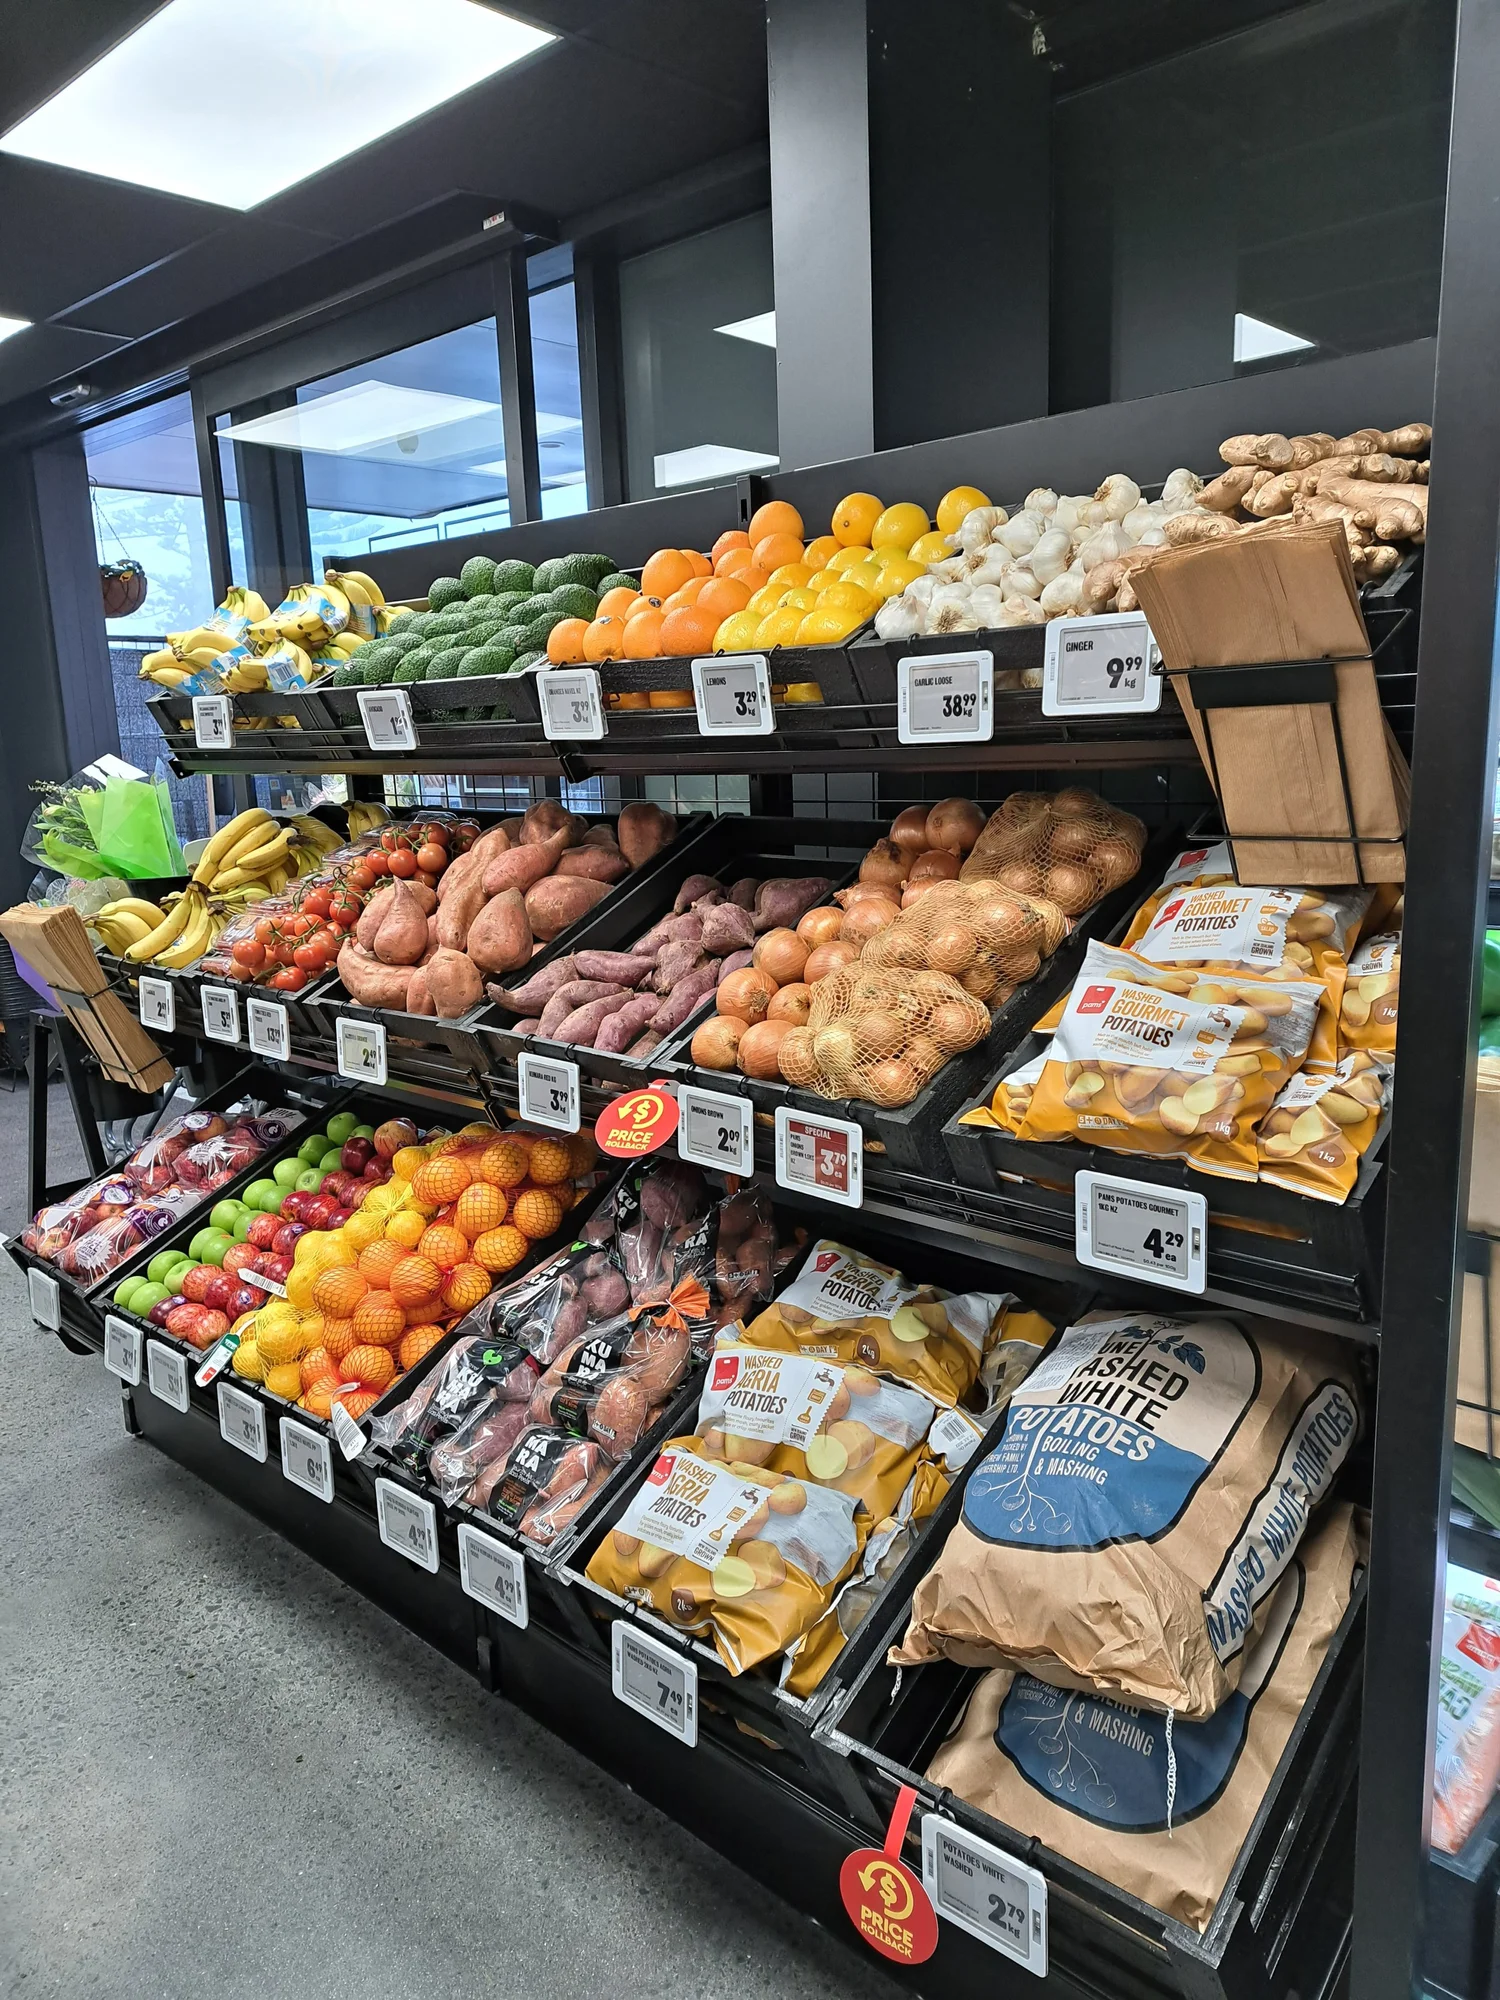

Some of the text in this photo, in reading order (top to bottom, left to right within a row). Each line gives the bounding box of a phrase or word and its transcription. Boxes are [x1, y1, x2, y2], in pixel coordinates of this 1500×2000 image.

[1065, 640, 1094, 652] GINGER
[706, 677, 727, 686] LEMONS
[914, 676, 953, 687] GARLIC LOOSE
[1124, 678, 1136, 688] kg
[963, 707, 973, 718] kg
[1190, 890, 1225, 904] WASHED
[1182, 897, 1253, 917] GOURMET
[1173, 914, 1240, 933] POTATOES
[1250, 946, 1274, 957] GROWN
[1361, 961, 1383, 971] GROWN
[1121, 988, 1163, 1005] WASHED
[1082, 1001, 1102, 1010] pams
[1382, 1007, 1397, 1018] 1kg
[1111, 999, 1191, 1031] GOURMET
[1101, 1014, 1174, 1048] POTATOES
[690, 1104, 724, 1119] ONIONS BROWN
[607, 1128, 654, 1144] PRICE
[804, 1125, 832, 1140] SPECIAL
[1214, 1120, 1231, 1136] 1kg
[604, 1140, 649, 1151] ROLLBACK
[729, 1145, 737, 1156] kg
[790, 1142, 804, 1151] ONIONS
[1318, 1150, 1335, 1168] 1kg
[1097, 1192, 1179, 1217] PAMS POTATOES GOURMET
[1098, 1202, 1119, 1214] 1KG NZ
[684, 1233, 708, 1250] RA
[1165, 1253, 1177, 1263] ea
[842, 1261, 885, 1287] WASHED
[829, 1269, 881, 1297] AGRIA
[820, 1279, 882, 1312] POTATOES
[584, 1338, 613, 1359] KU
[861, 1344, 876, 1360] 2kg
[1099, 1341, 1143, 1355] UNE
[580, 1350, 607, 1373] MA
[744, 1355, 784, 1370] WASHED
[715, 1379, 733, 1387] pams
[734, 1369, 780, 1393] AGRIA
[1076, 1356, 1189, 1402] ASHED
[724, 1390, 787, 1415] POTATOES
[1056, 1380, 1169, 1432] WHITE
[1009, 1405, 1156, 1462] POTATOES
[1023, 1433, 1029, 1442] &
[524, 1435, 549, 1457] MA
[1001, 1442, 1028, 1451] PACKED BY
[1041, 1435, 1100, 1462] BOILING
[514, 1448, 541, 1473] RA
[1001, 1452, 1025, 1463] FAMILY
[675, 1456, 718, 1486] WASHED
[1005, 1464, 1019, 1474] LTD.
[1034, 1457, 1109, 1486] & MASHING
[663, 1471, 710, 1507] AGRIA
[648, 1496, 707, 1529] POTATOES
[1205, 1391, 1354, 1653] WASHED WHITE POTATOES
[693, 1546, 715, 1561] GROWN
[626, 1642, 673, 1677] PAMS POTATOES AGRIA
[626, 1650, 659, 1676] WASHED 2KG NZ
[1041, 1696, 1057, 1710] LTD.
[1074, 1701, 1156, 1757] & MASHING
[943, 1839, 1006, 1884] POTATOES WHITE
[943, 1852, 974, 1878] WASHED
[860, 1904, 914, 1949] PRICE
[1007, 1925, 1021, 1940] kg
[860, 1920, 913, 1959] ROLLBACK
